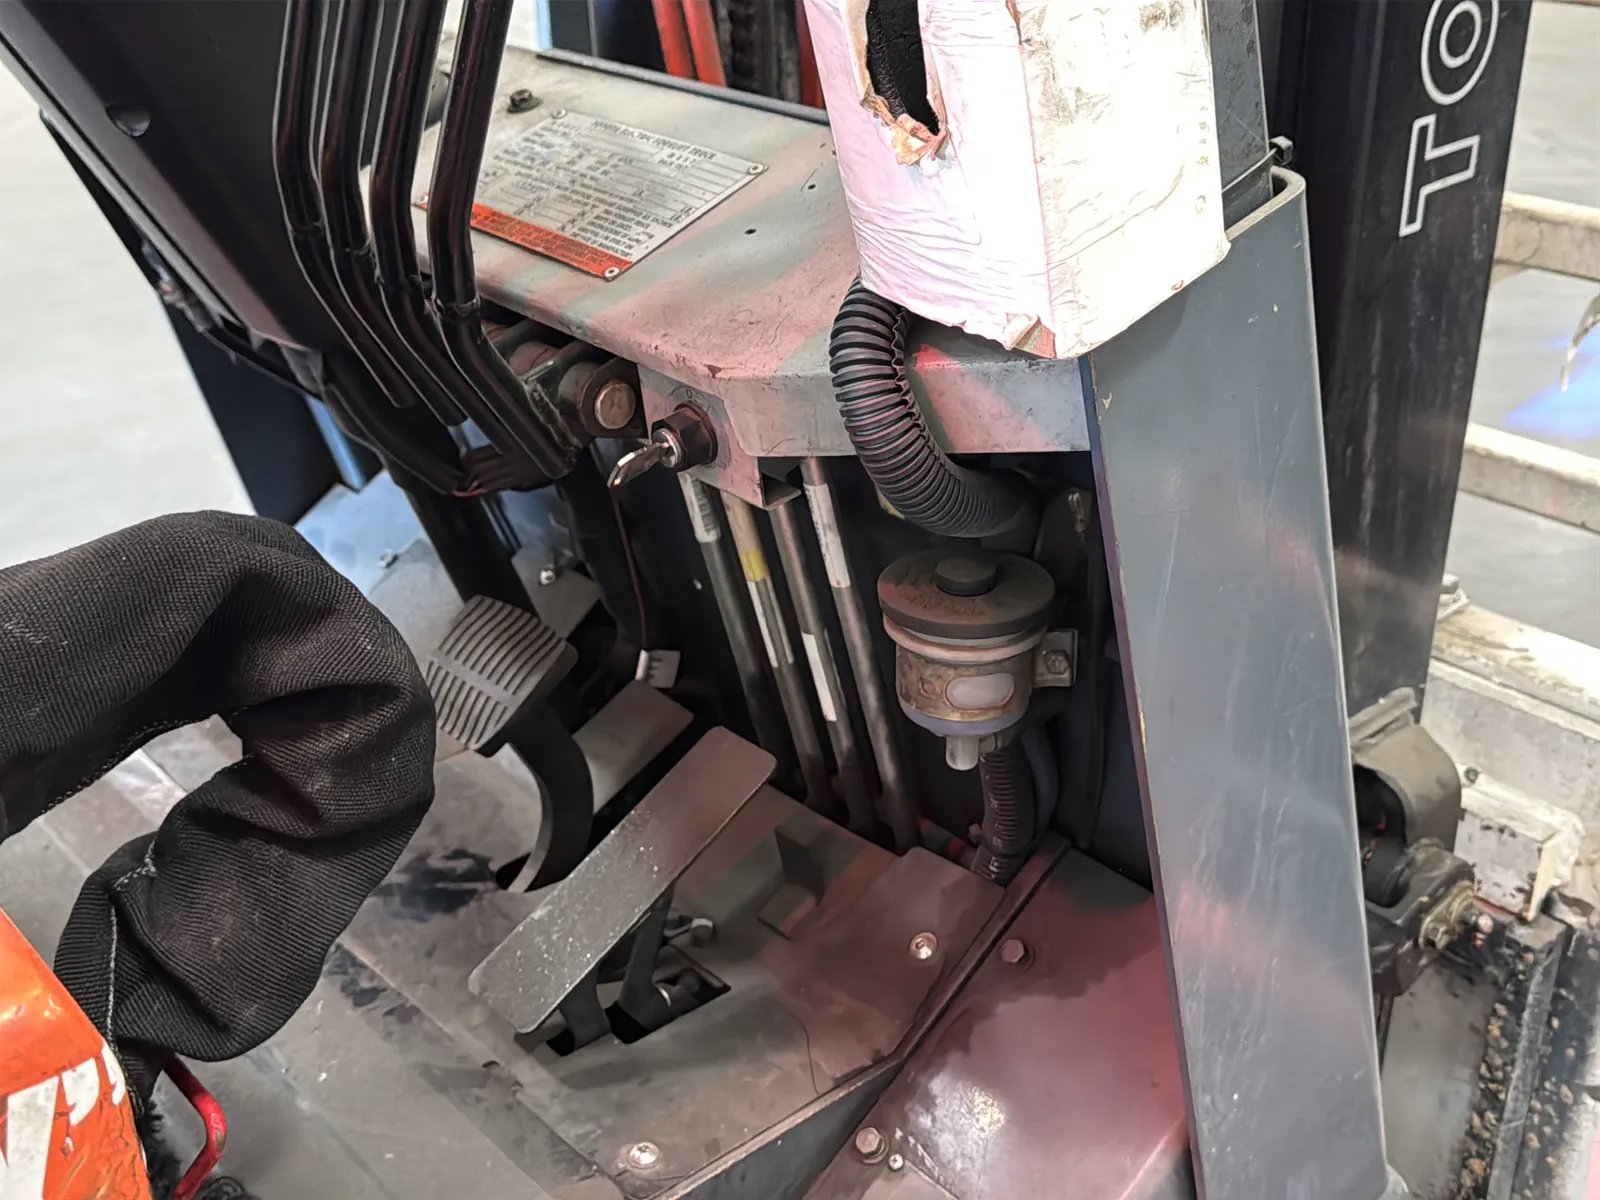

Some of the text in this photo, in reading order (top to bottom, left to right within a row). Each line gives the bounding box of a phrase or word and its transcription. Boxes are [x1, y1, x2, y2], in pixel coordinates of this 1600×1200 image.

[592, 120, 620, 133] TOYOTA
[652, 138, 690, 152] FORKLIFT
[689, 147, 717, 160] TRUCK
[1399, 0, 1499, 237] TO
